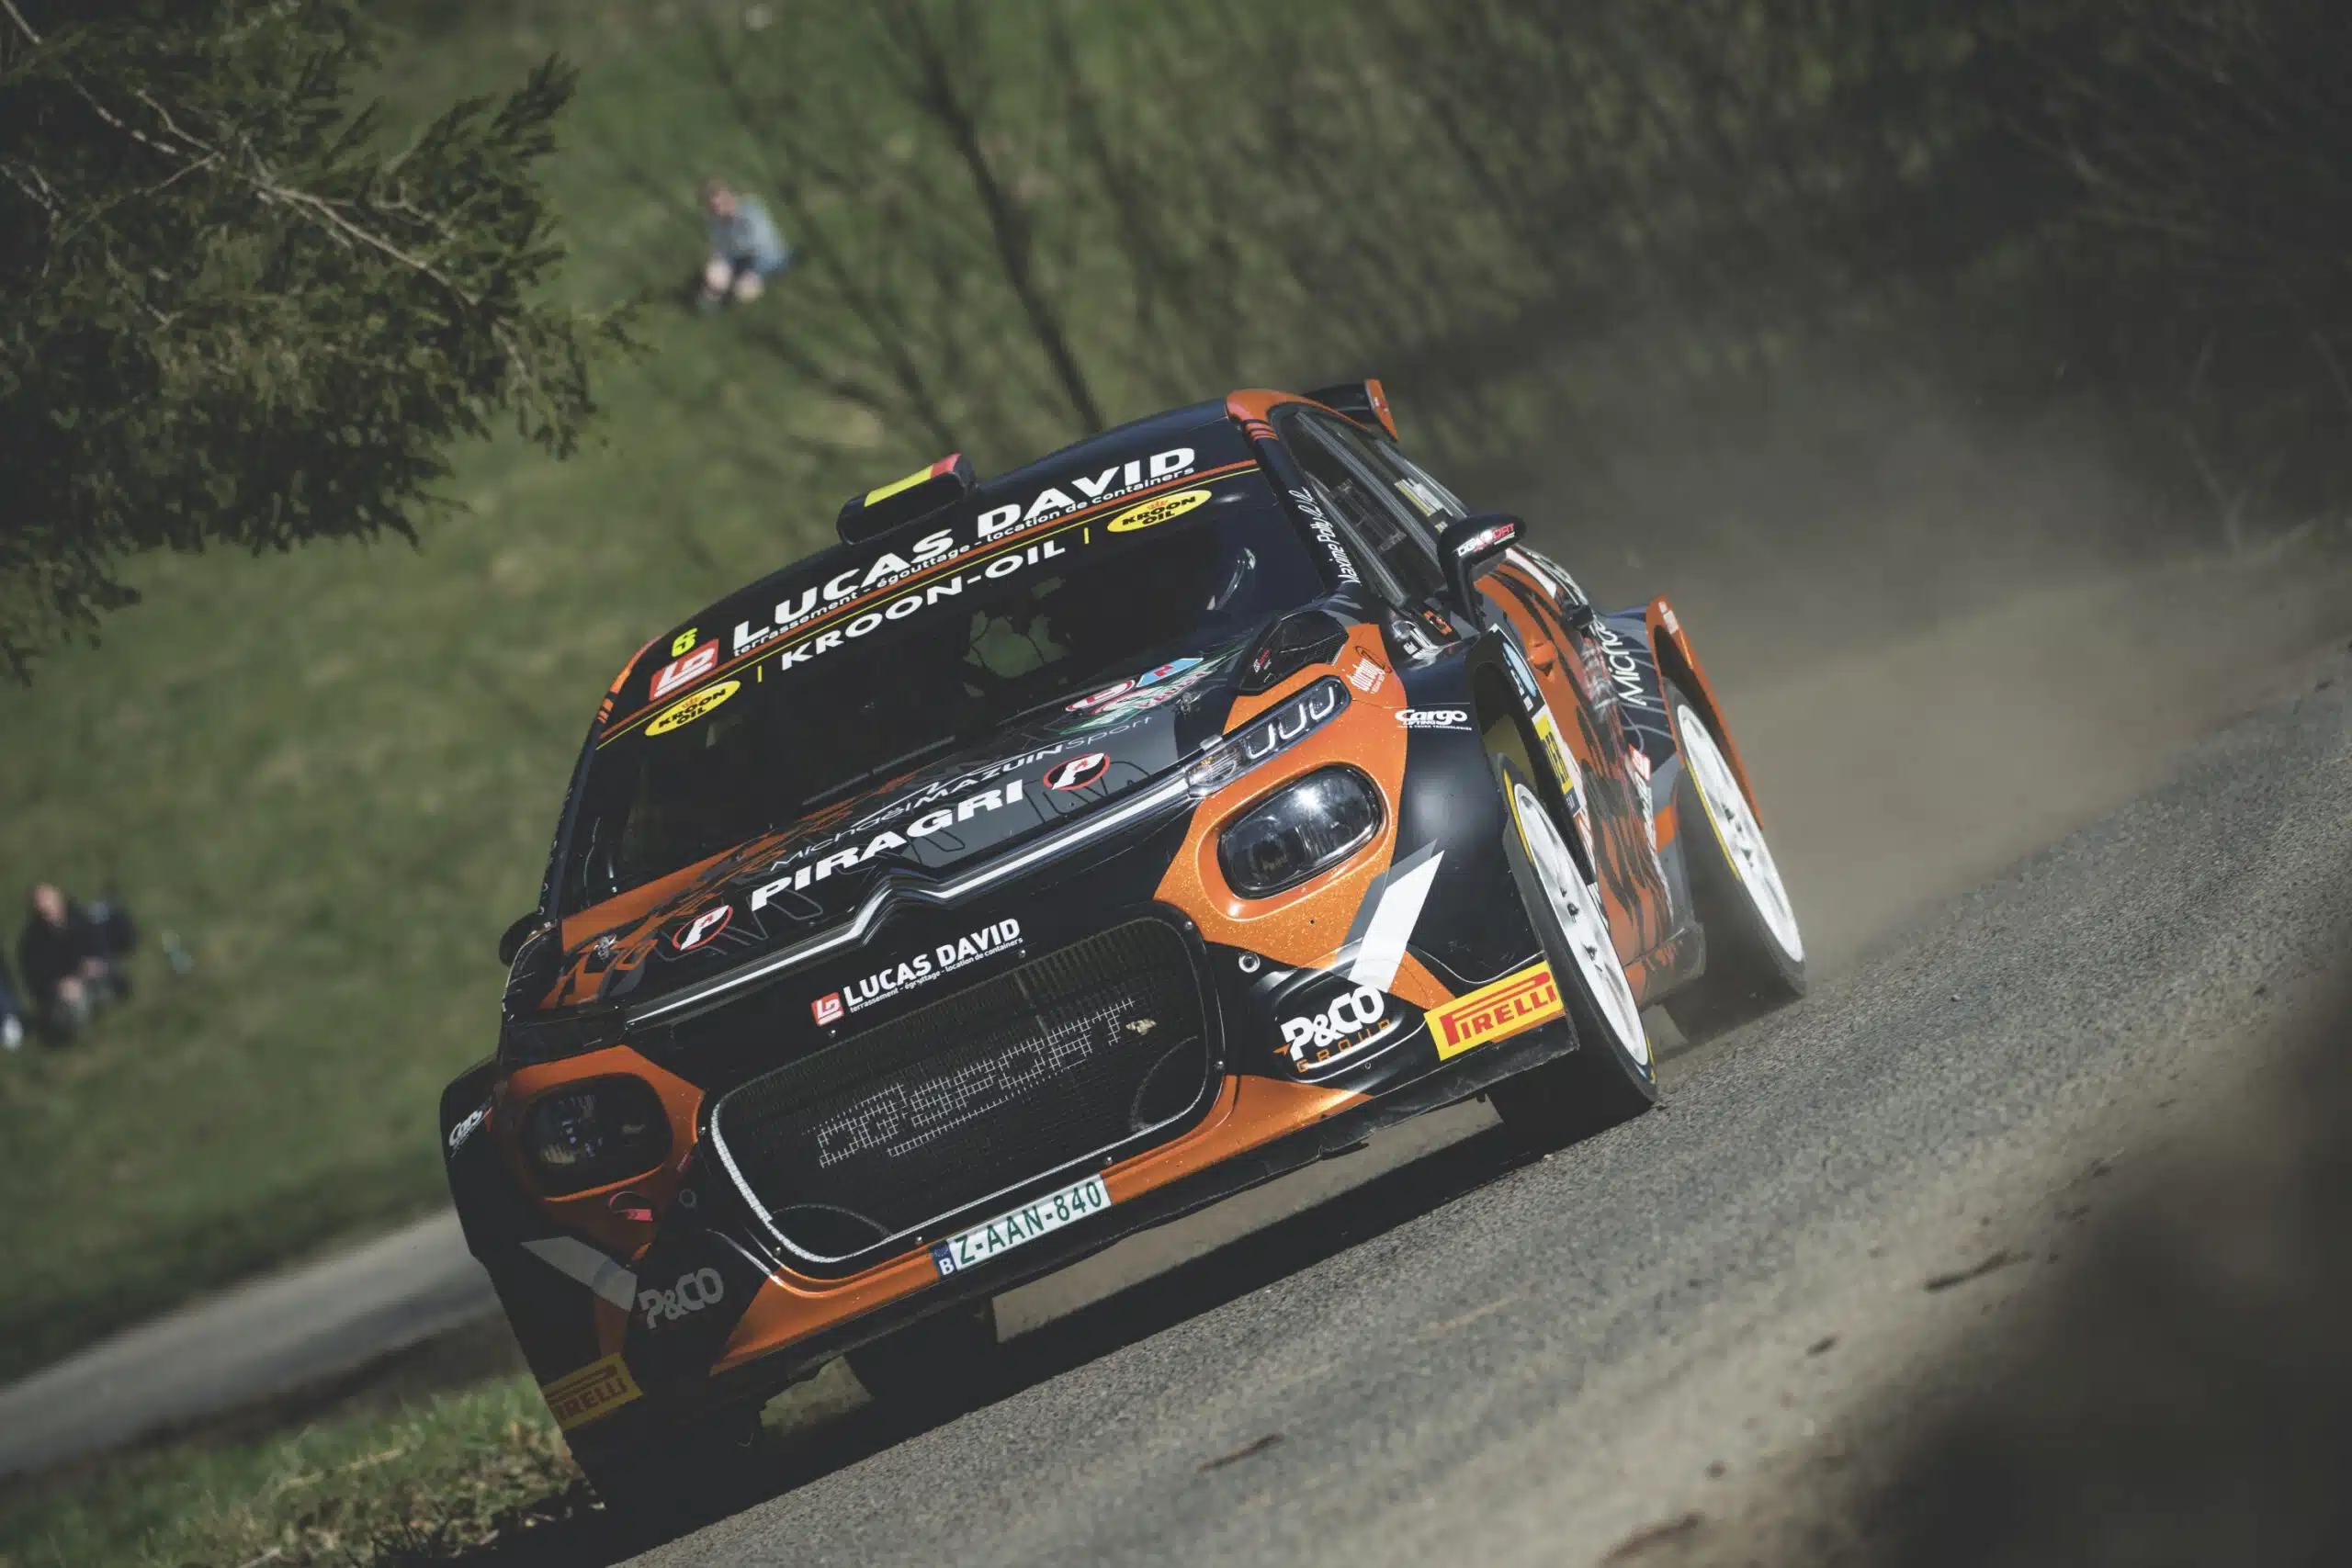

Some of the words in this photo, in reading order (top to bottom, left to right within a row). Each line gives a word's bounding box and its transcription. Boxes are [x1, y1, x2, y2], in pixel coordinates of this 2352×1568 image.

[733, 528, 954, 649] LUCAS
[978, 447, 1195, 537] DAVID
[1122, 496, 1196, 526] KROON
[1142, 510, 1175, 525] OIL
[734, 591, 858, 657] terrassement
[876, 544, 970, 589] égouttage
[987, 509, 1060, 542] location
[1065, 500, 1088, 513] de
[1091, 467, 1194, 504] containers
[782, 540, 1066, 671] KROON-OIL
[658, 689, 727, 728] KROON
[676, 706, 707, 725] OIL
[1395, 709, 1467, 725] Cargo
[751, 780, 1023, 912] PIRAGRI
[842, 953, 932, 1007] LUCAS
[935, 918, 1021, 968] DAVID
[850, 987, 899, 1013] terrassement
[944, 957, 974, 972] location
[975, 953, 984, 961] de
[984, 938, 1023, 956] containers
[1280, 985, 1385, 1062] P&CO
[1439, 970, 1557, 1047] PIRELLI
[938, 1258, 955, 1276] B
[954, 1181, 1102, 1265] Z-AAN-840
[638, 1267, 724, 1329] P&CO
